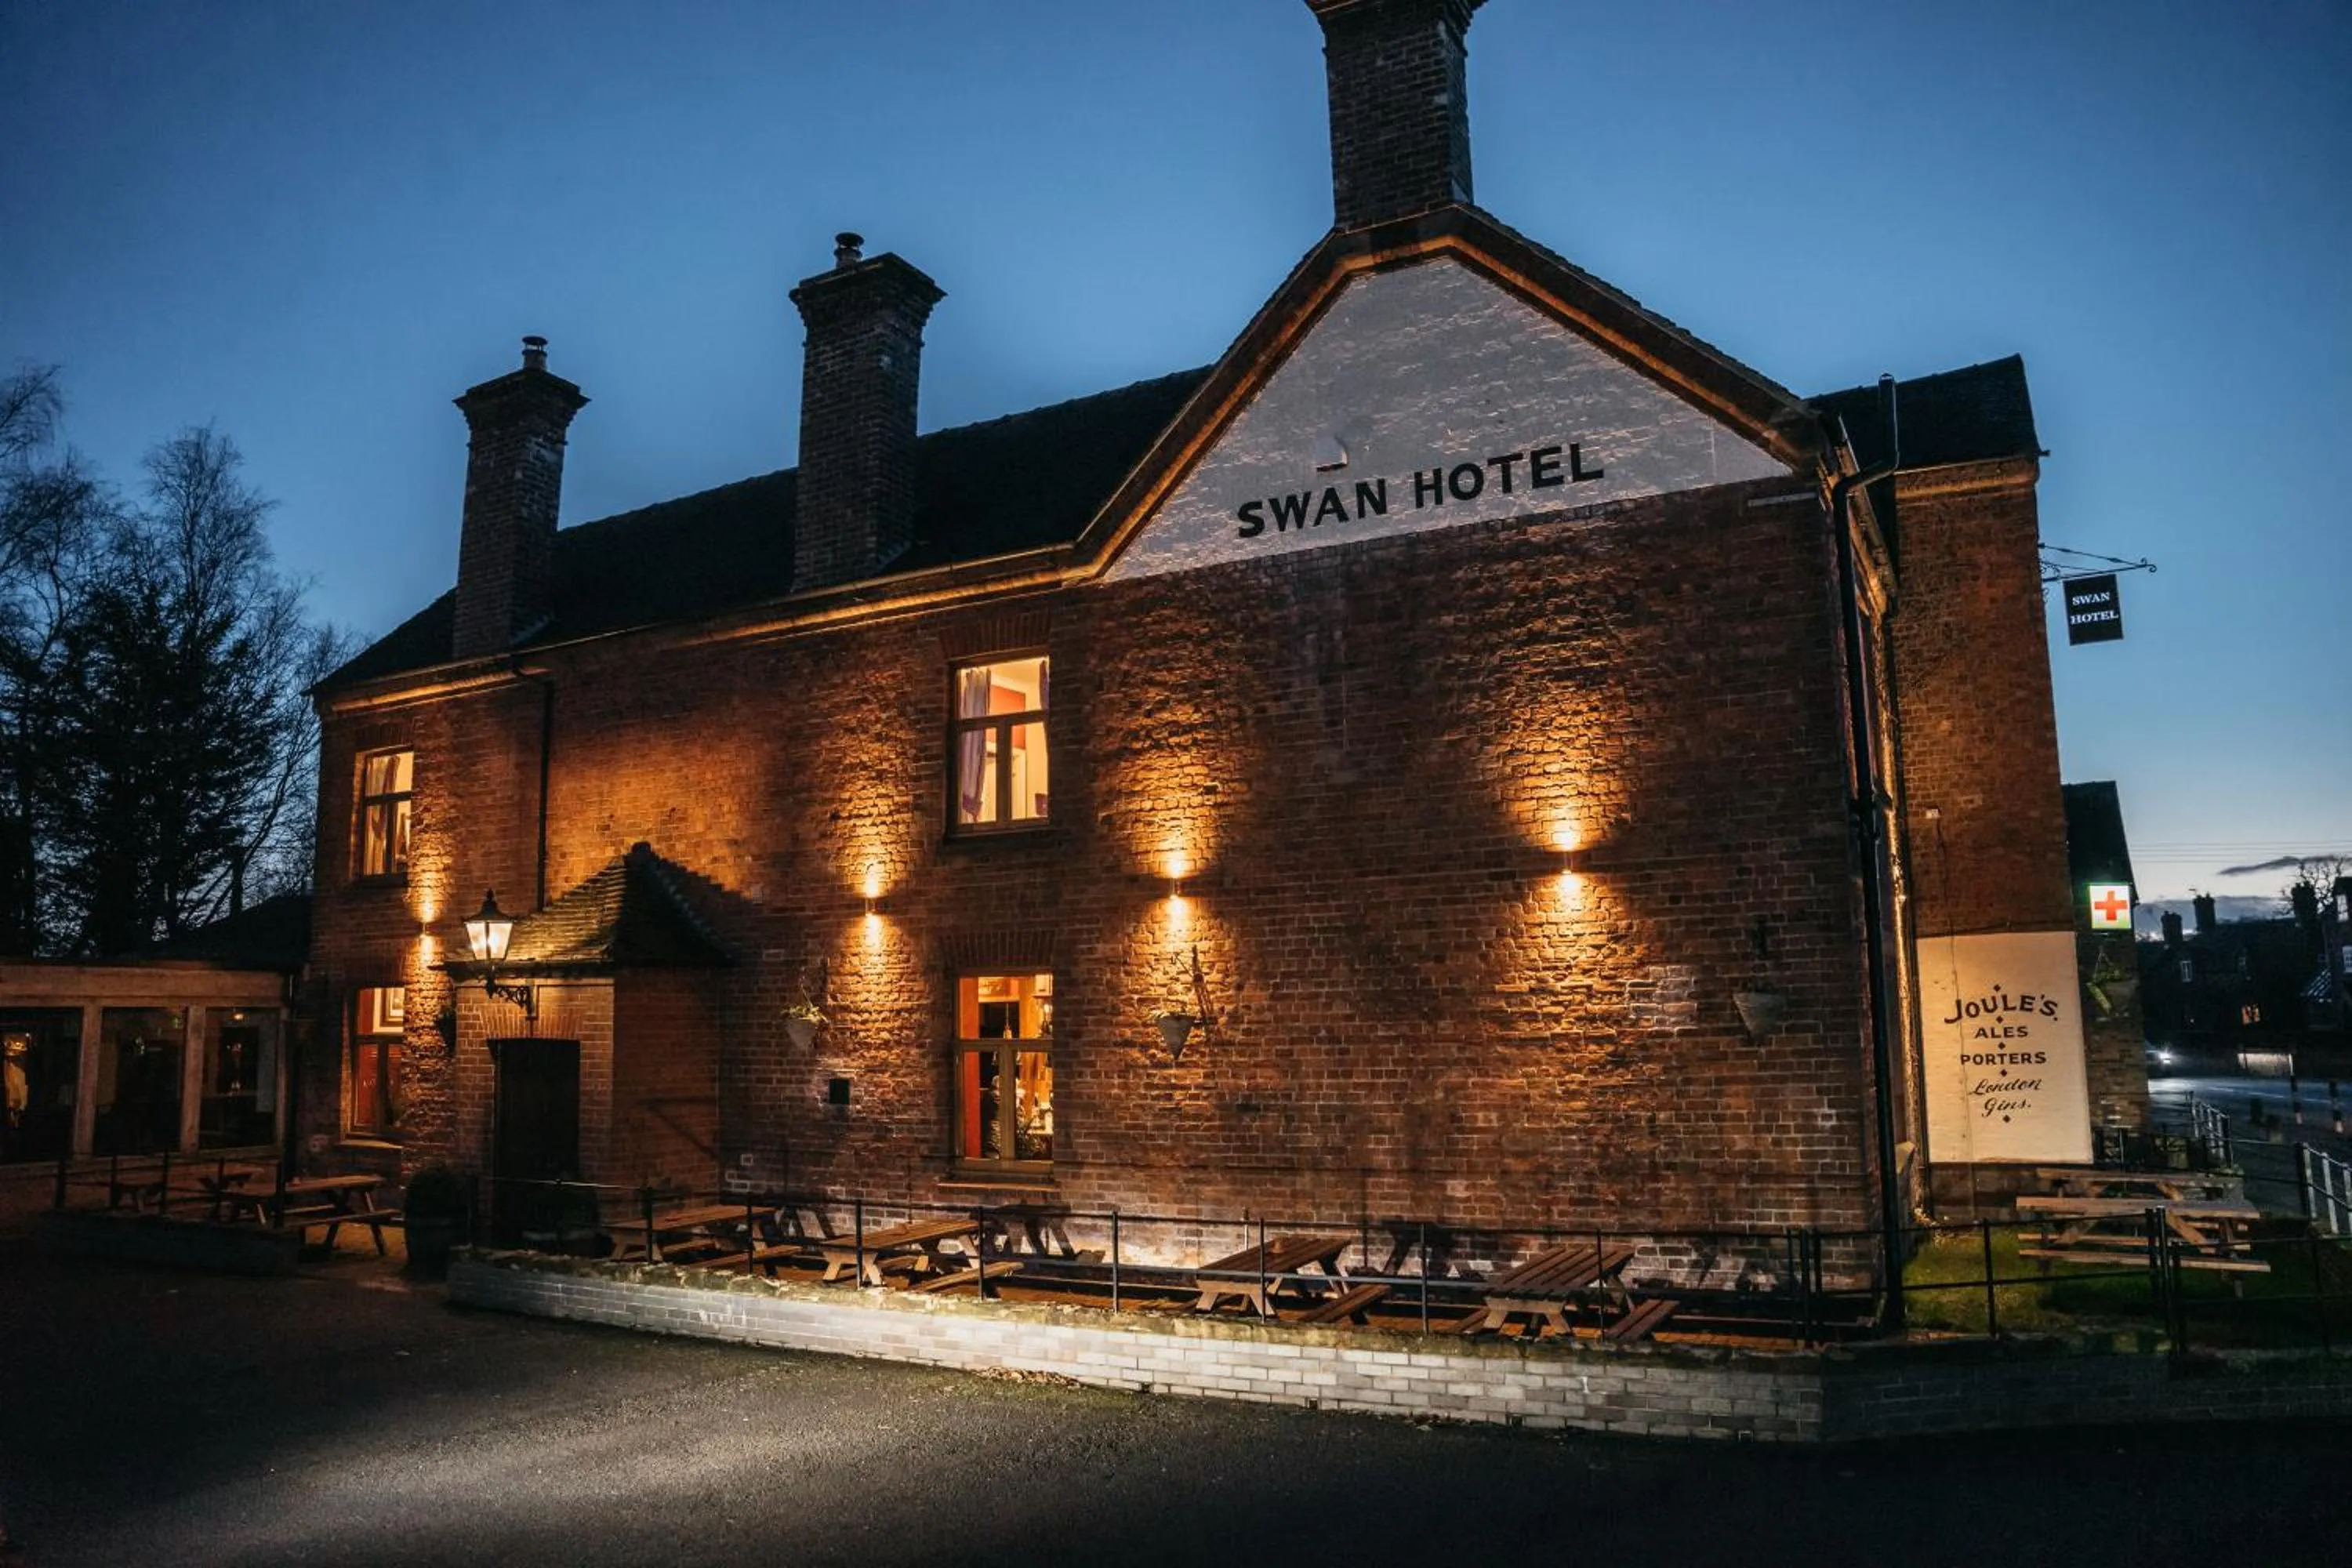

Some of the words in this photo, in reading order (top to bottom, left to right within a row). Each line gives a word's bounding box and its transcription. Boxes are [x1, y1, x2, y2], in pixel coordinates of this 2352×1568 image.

[1237, 477, 1388, 539] SWAN
[1414, 442, 1605, 509] HOTEL
[2072, 591, 2111, 605] SWAN
[2070, 610, 2119, 625] HOTEL
[1975, 1026, 2028, 1039] ALES
[1960, 1051, 2047, 1065] PORTERS
[1969, 1078, 2042, 1095] London
